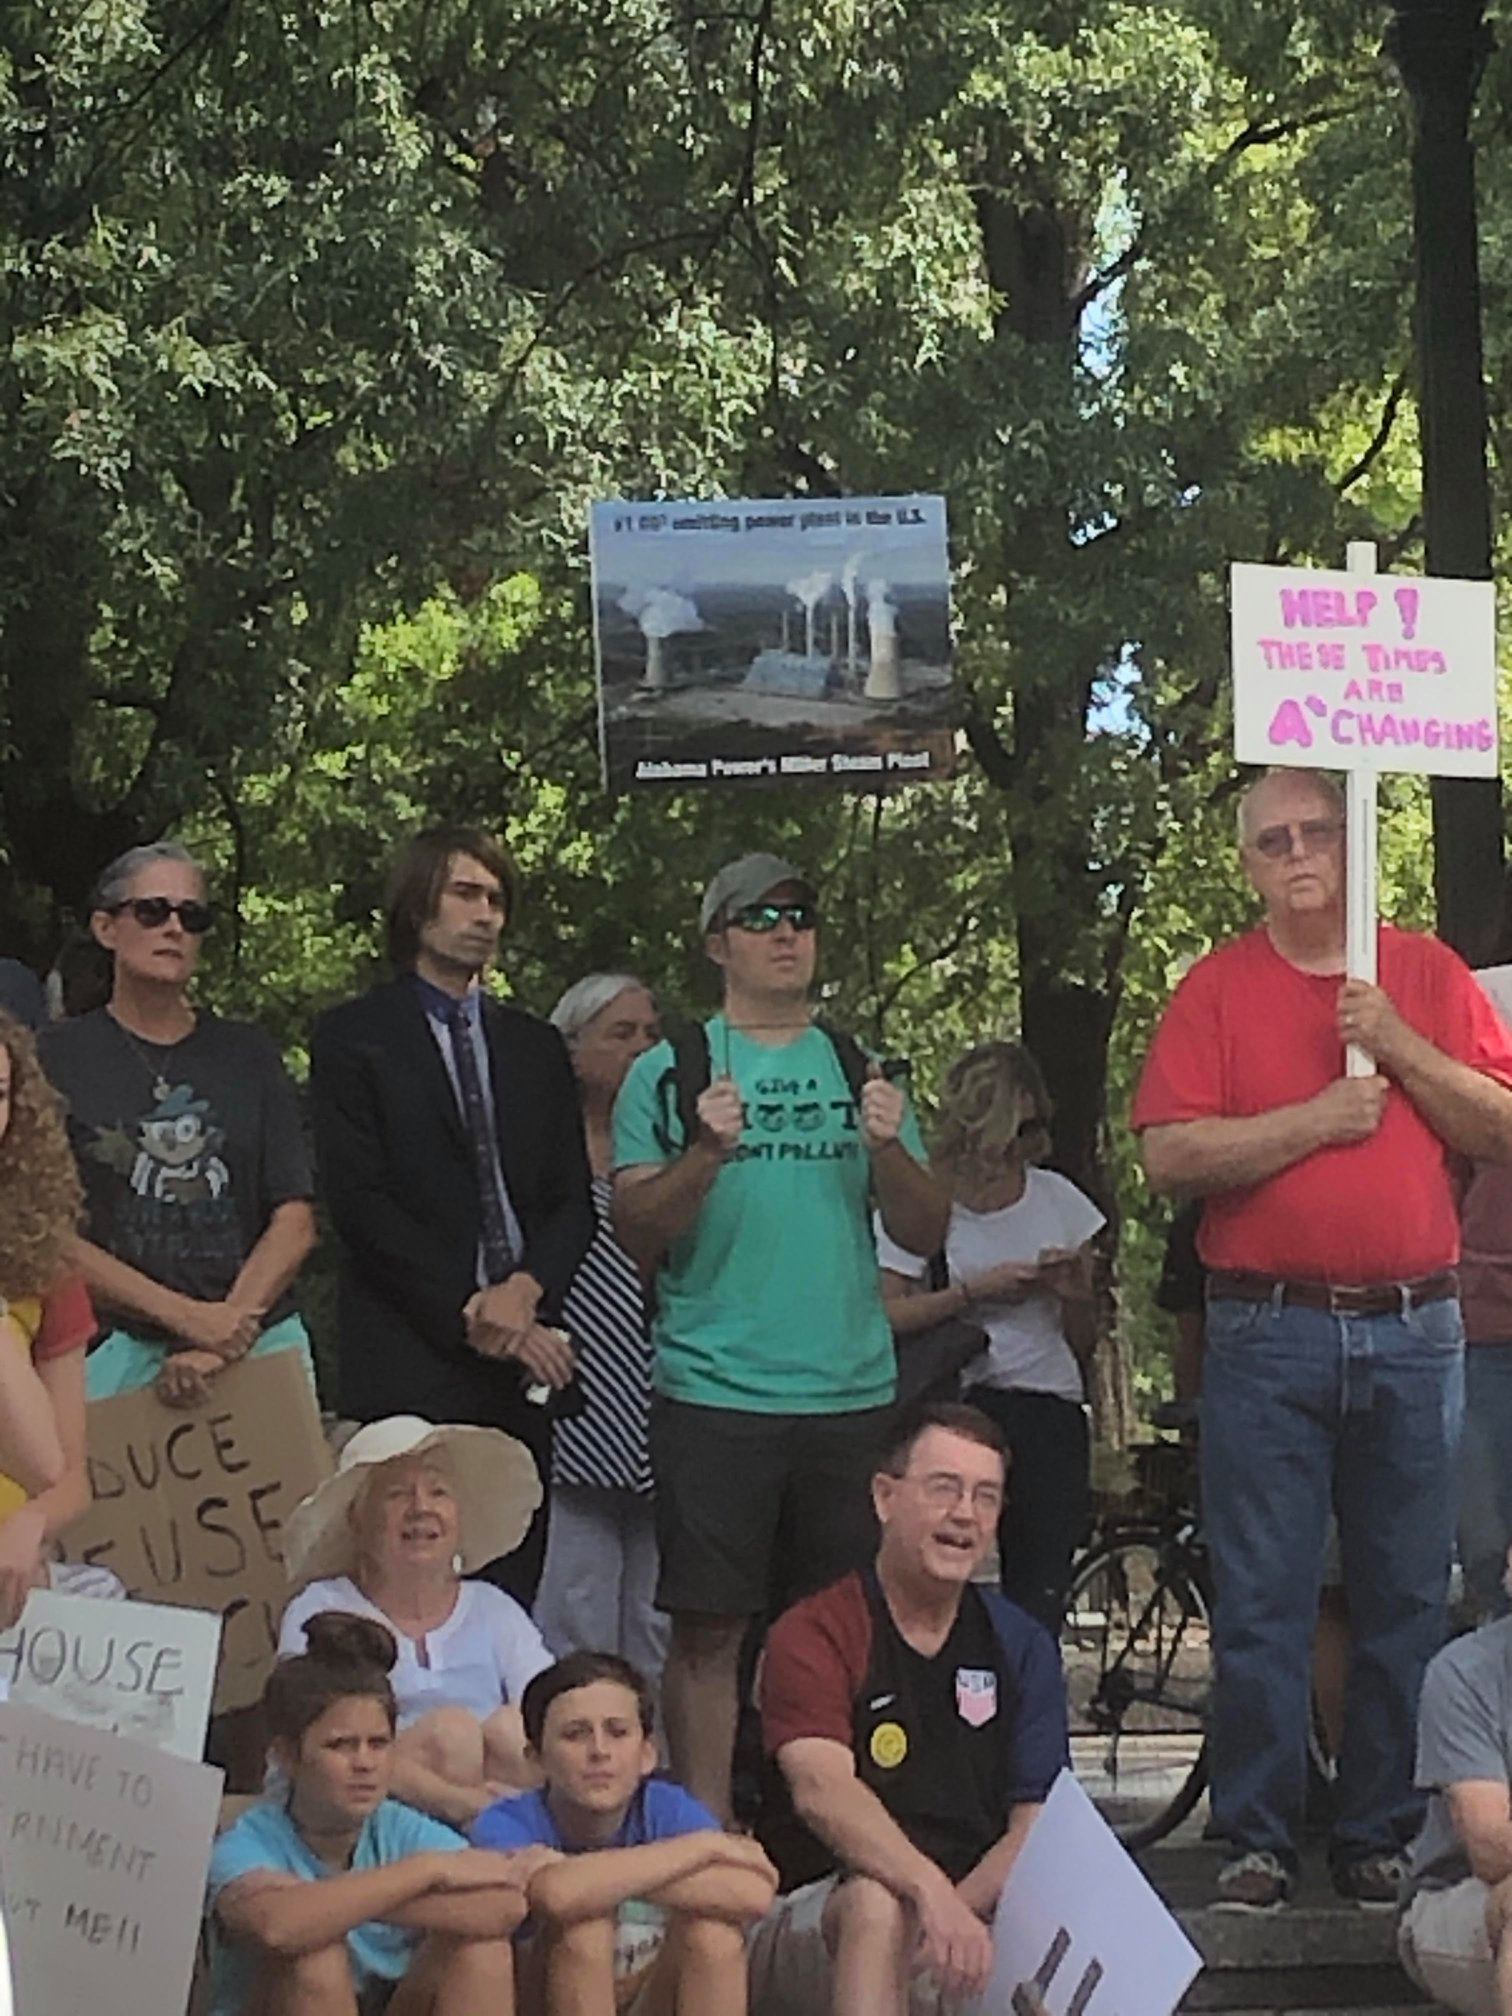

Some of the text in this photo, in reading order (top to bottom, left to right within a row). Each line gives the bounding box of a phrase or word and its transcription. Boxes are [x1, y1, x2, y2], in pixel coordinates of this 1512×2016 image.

[745, 514, 794, 531] power
[845, 510, 861, 526] in
[865, 510, 890, 526] the
[1280, 588, 1378, 628] HELP
[1257, 638, 1447, 675] THESE TIMES
[1344, 678, 1404, 703] ARE
[1331, 708, 1494, 753] CHANGING
[636, 760, 707, 779] Alabama
[806, 1078, 816, 1091] A
[16, 1736, 153, 1809] HAVE TO
